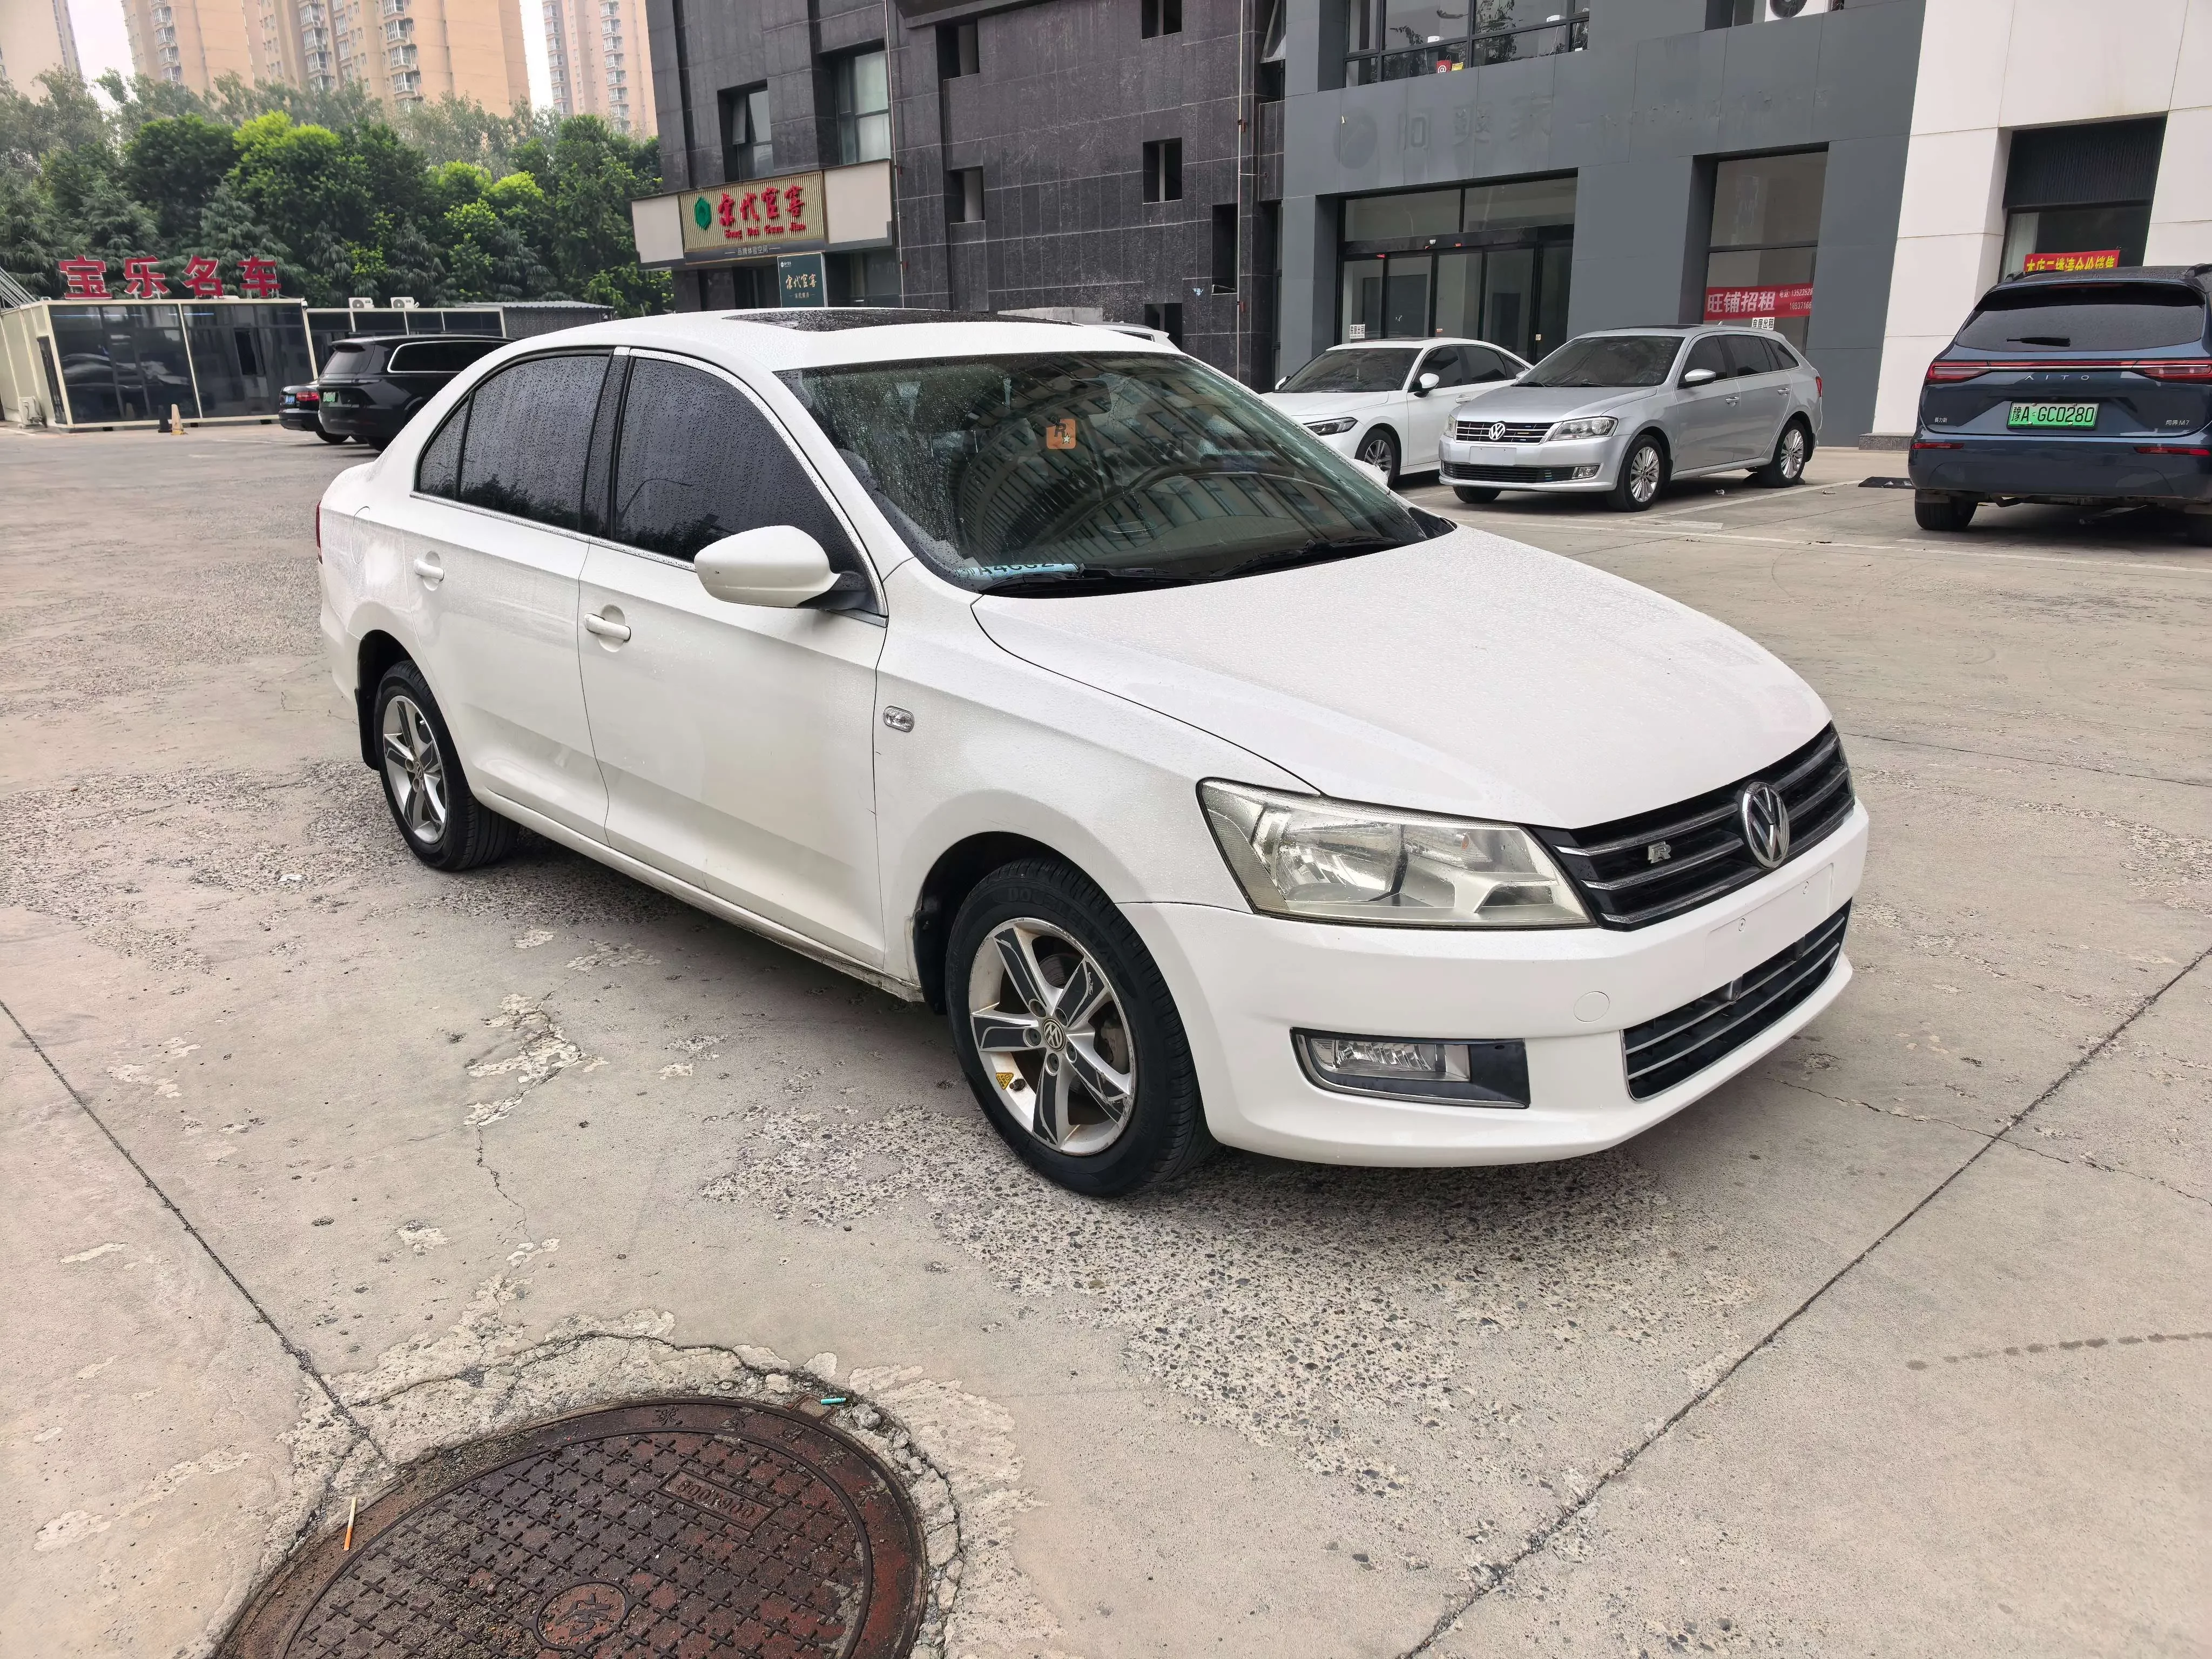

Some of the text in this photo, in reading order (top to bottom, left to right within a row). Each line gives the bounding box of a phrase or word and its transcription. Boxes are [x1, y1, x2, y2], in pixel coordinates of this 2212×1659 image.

[59, 255, 281, 299] 宝乐名车
[1707, 291, 1776, 313] 旺铺招租
[1753, 319, 1774, 329] 房屋出租
